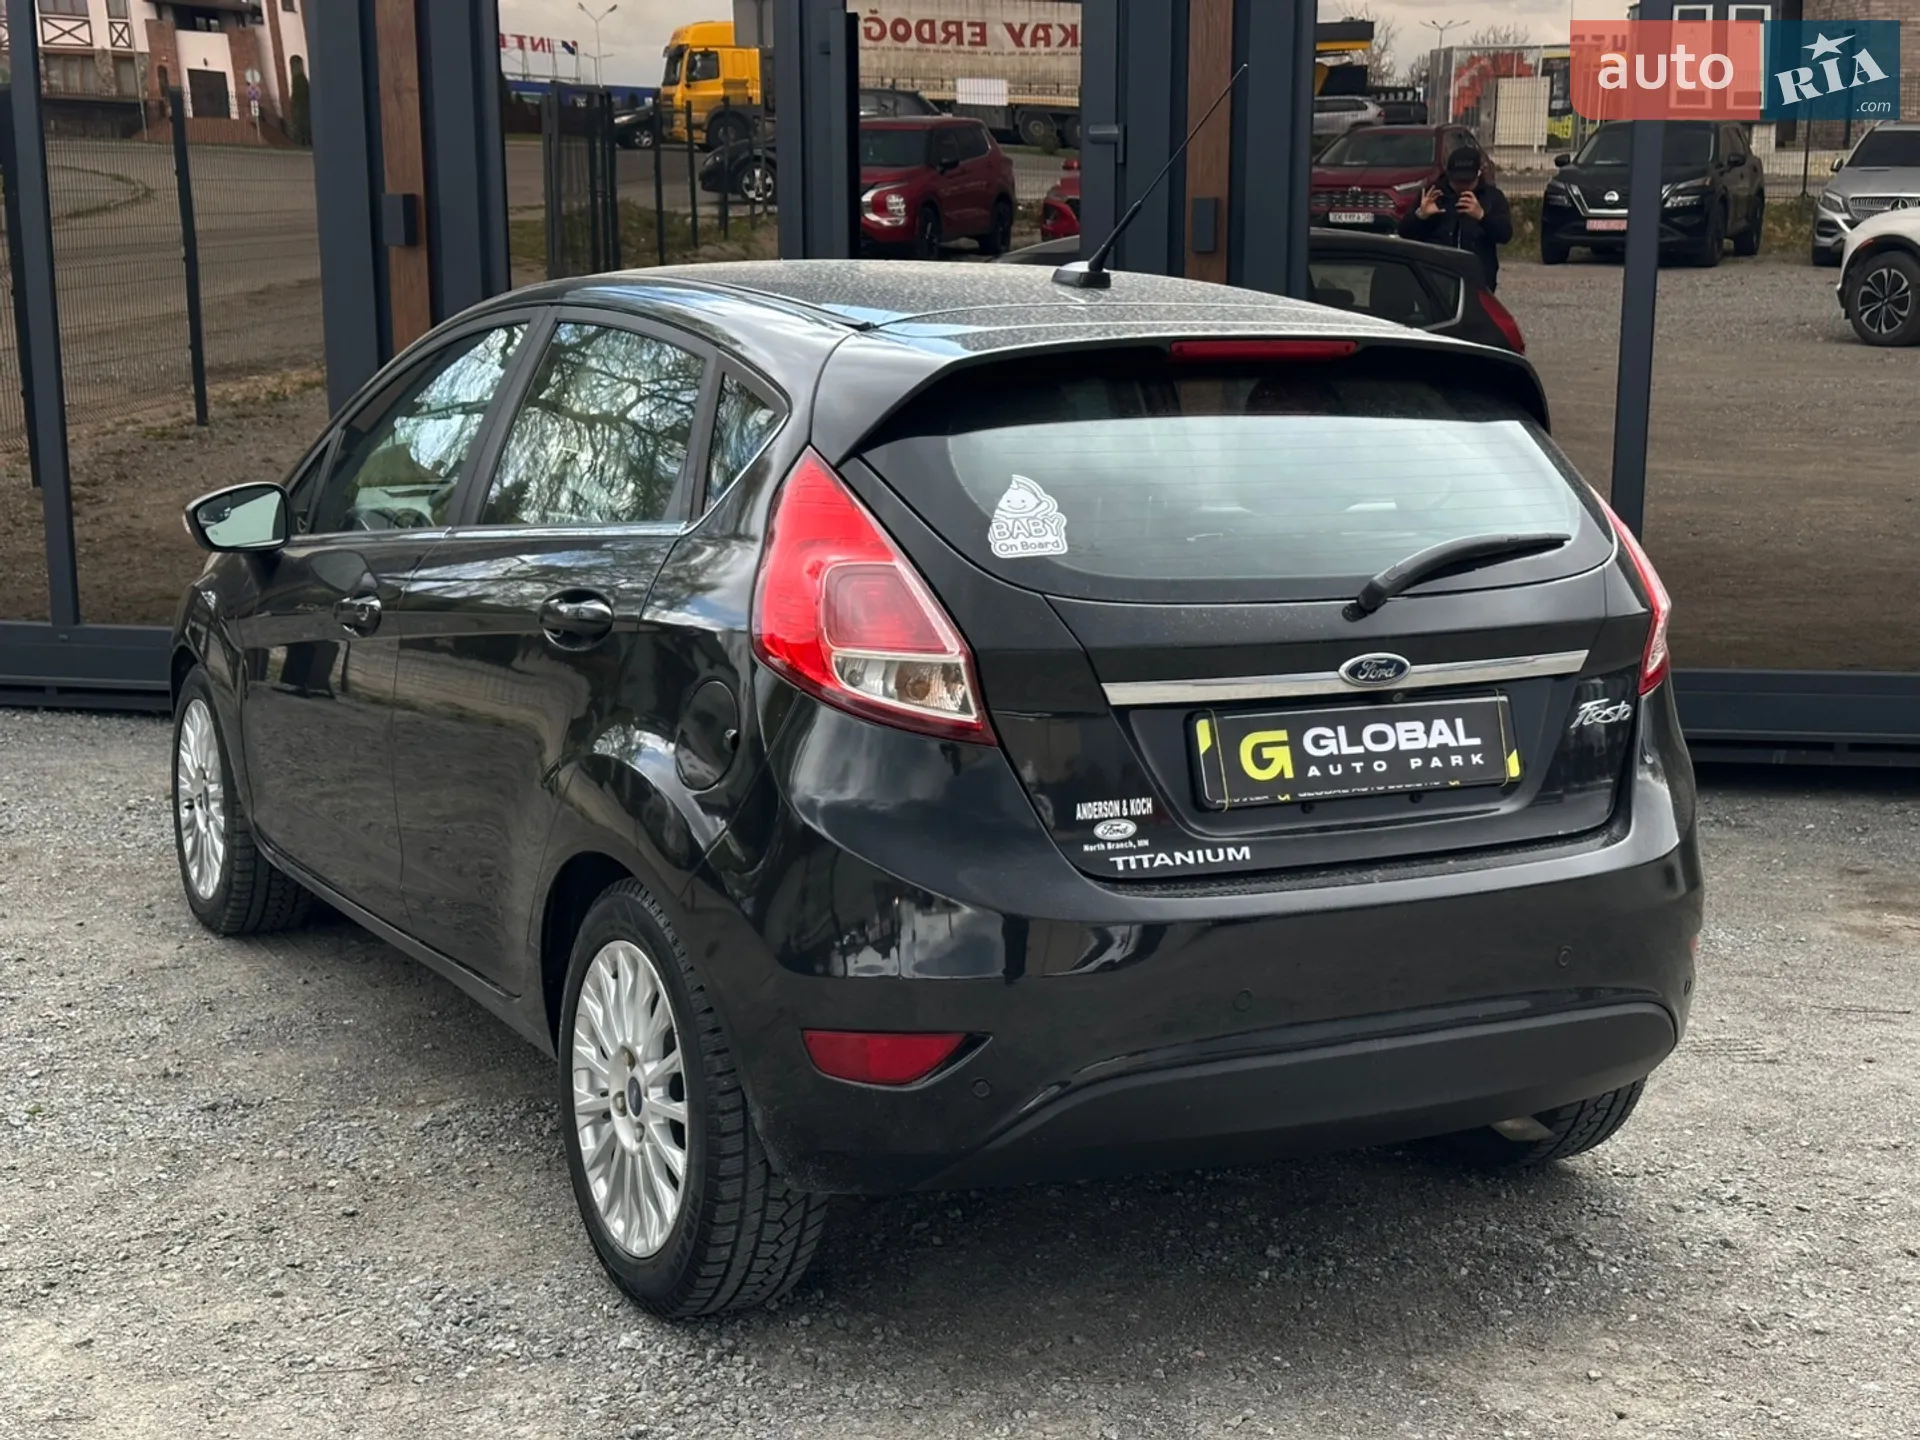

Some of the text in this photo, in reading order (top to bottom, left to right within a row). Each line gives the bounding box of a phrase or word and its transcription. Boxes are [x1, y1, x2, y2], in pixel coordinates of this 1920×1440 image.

[992, 518, 1060, 540] BABY
[998, 539, 1060, 553] On Board
[1357, 659, 1398, 680] Ford
[1569, 697, 1633, 729] Fiesta
[1302, 717, 1482, 757] GLOBAL
[1307, 752, 1485, 778] AUTO PARK
[1075, 797, 1153, 820] ANDERSON & KOCH
[1101, 824, 1128, 836] Ford
[1083, 842, 1105, 852] North
[1107, 840, 1137, 850] Branch,
[1109, 845, 1251, 871] TITANIUM
